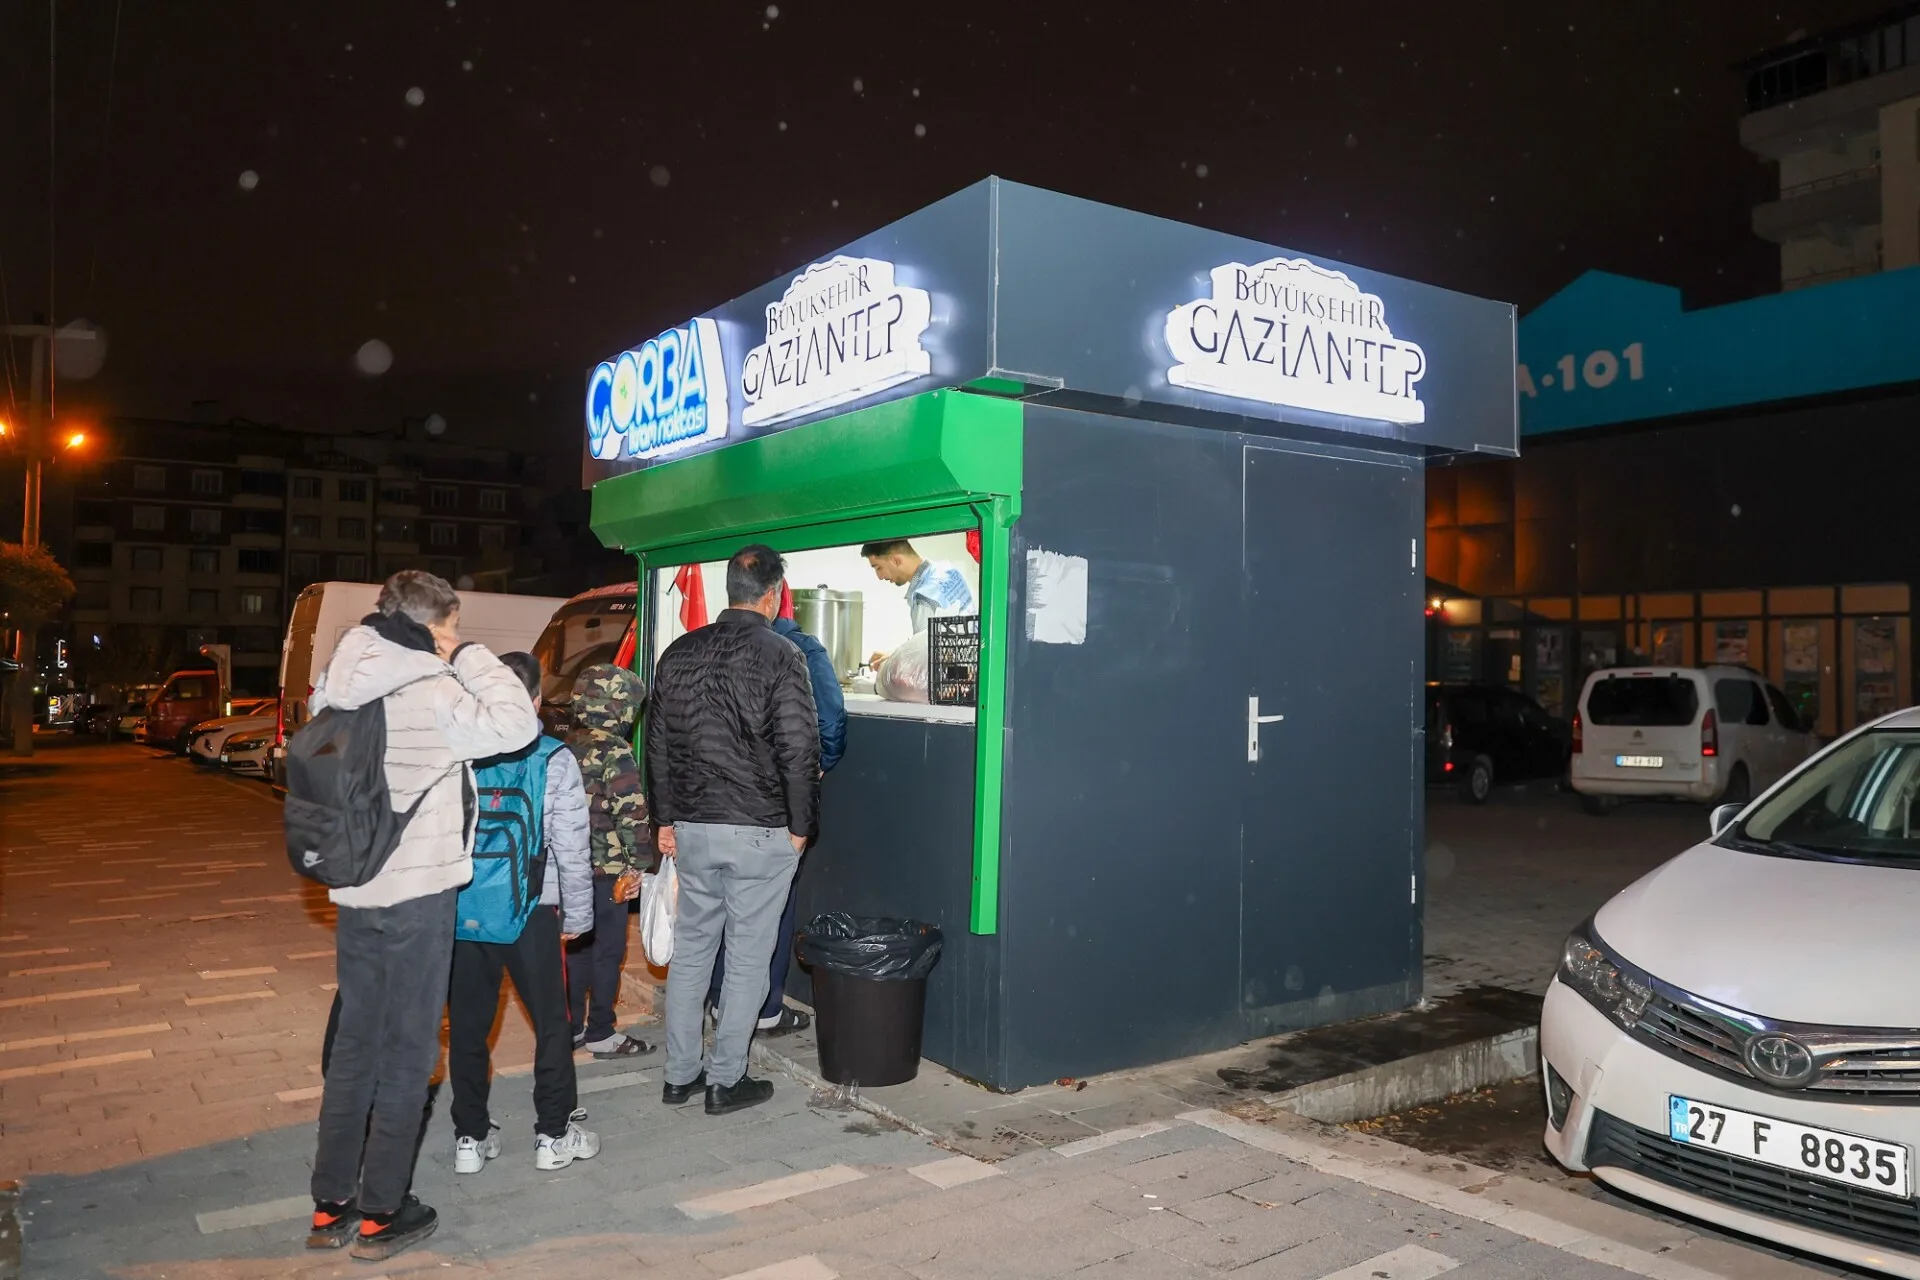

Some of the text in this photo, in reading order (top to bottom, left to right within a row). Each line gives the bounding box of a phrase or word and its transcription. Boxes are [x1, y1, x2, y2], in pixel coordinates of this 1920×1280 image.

[743, 293, 903, 400] GAZİANTEP
[1236, 268, 1384, 331] BÜYÜKŞEHİR
[588, 319, 706, 456] ÇORBA
[1190, 303, 1423, 398] GAZİANTEP
[1675, 1106, 1897, 1186] TR 27 F 8835
